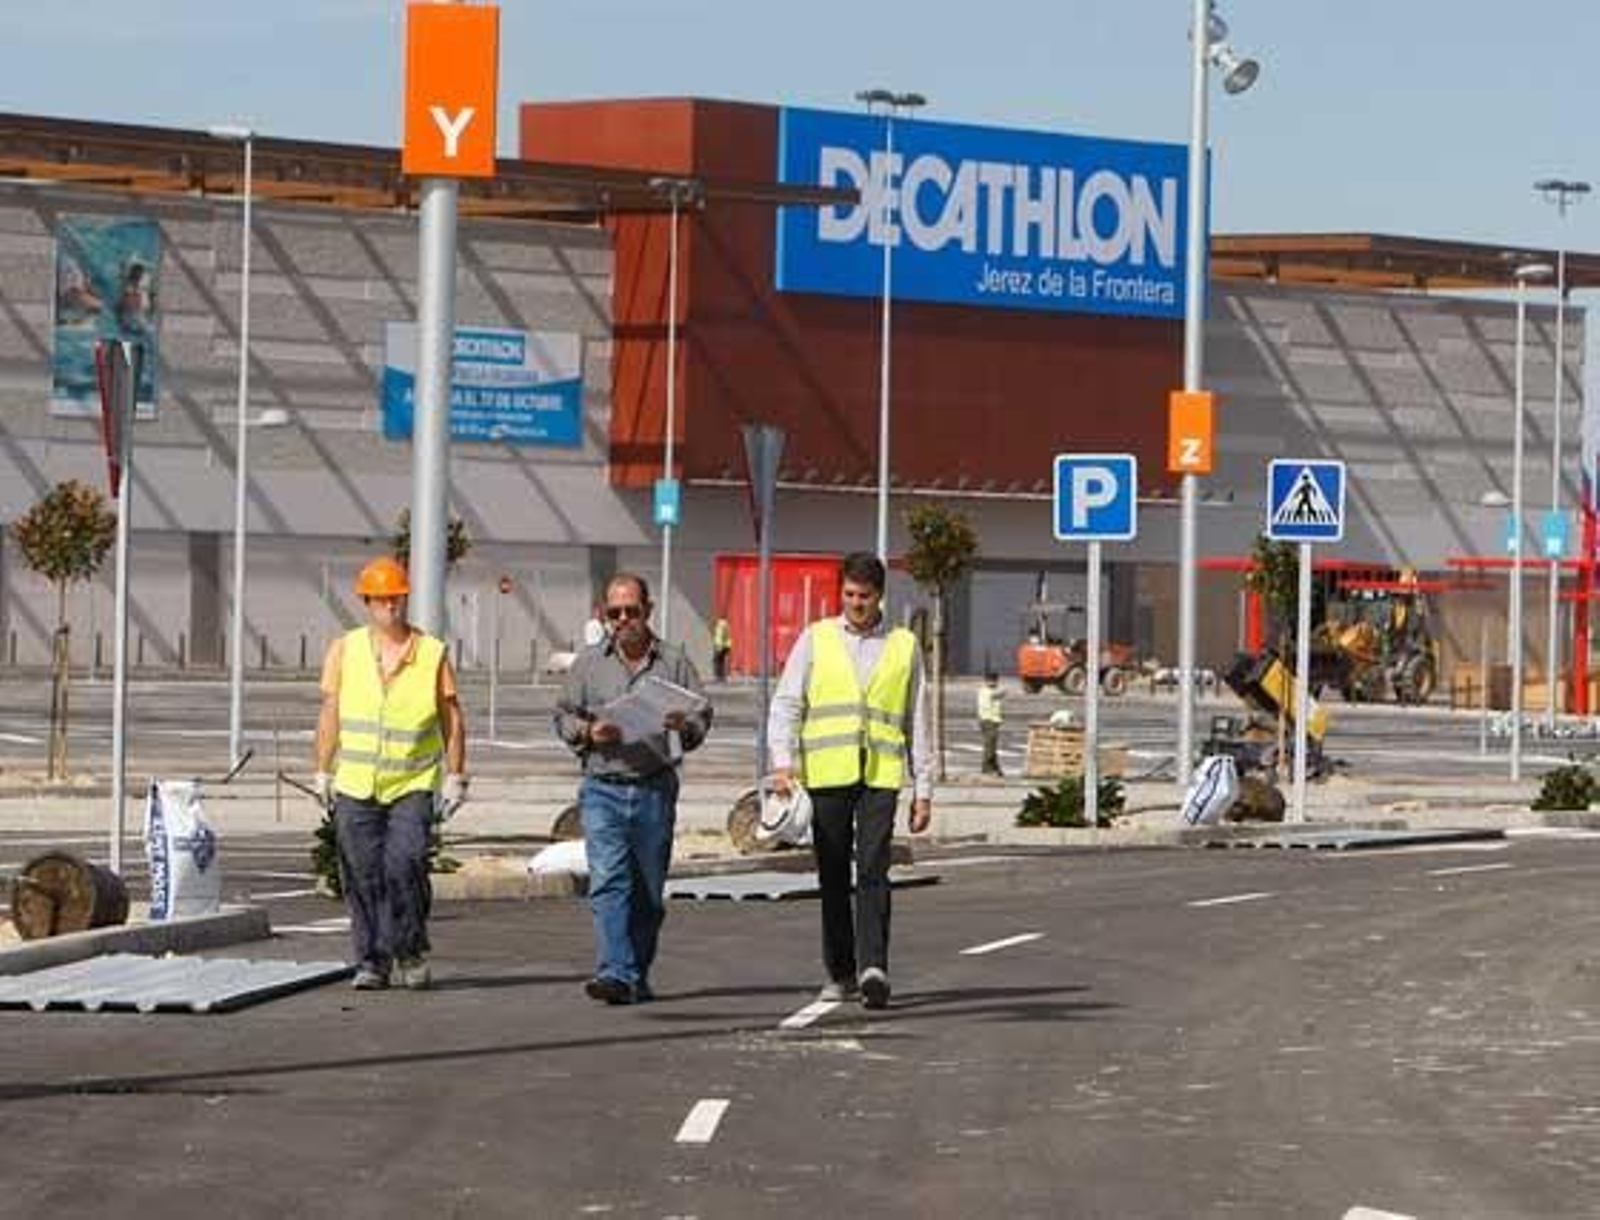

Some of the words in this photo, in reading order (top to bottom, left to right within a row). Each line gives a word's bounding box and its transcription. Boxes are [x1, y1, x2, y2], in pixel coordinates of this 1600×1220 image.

[429, 106, 476, 157] Y
[818, 147, 1177, 268] DECATHLON
[977, 261, 1032, 295] Jerez
[1038, 268, 1063, 297] de
[1069, 267, 1086, 298] la
[1093, 270, 1175, 306] Frontera
[1180, 439, 1202, 464] Z
[1073, 467, 1118, 529] P
